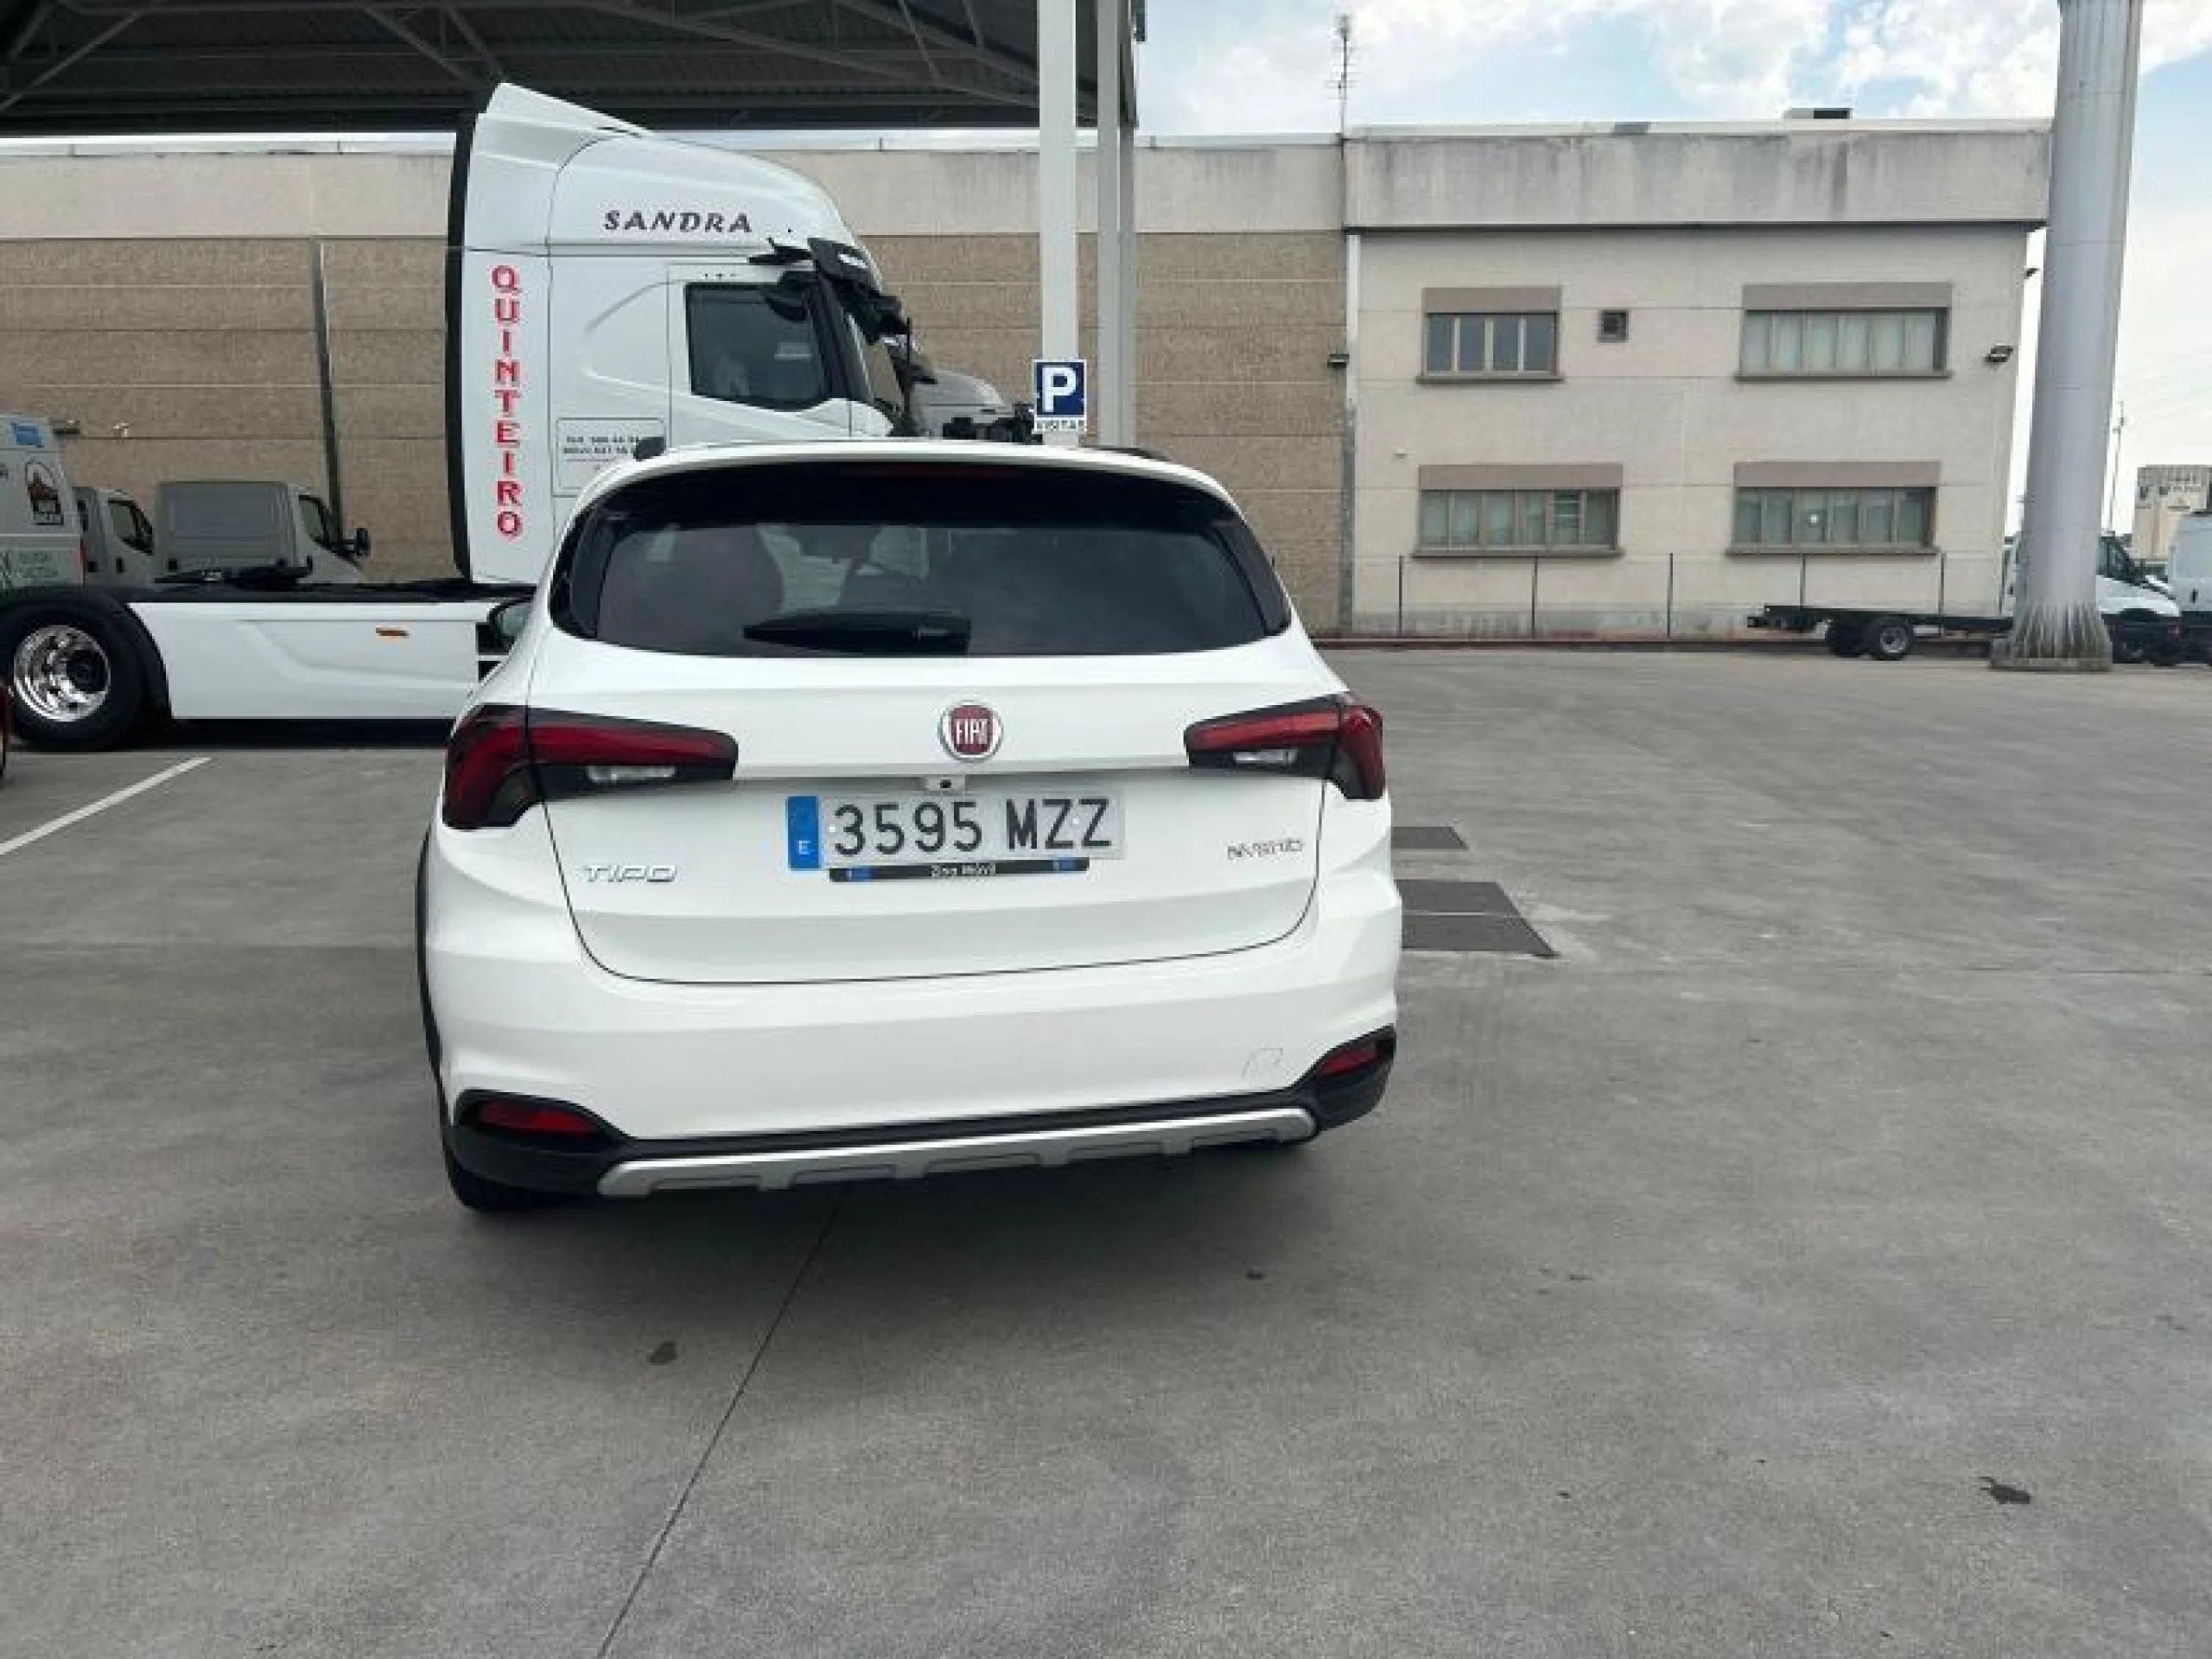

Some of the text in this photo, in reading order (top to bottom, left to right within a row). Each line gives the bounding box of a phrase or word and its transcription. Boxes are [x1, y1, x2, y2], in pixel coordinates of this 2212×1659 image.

[605, 210, 753, 232] SANDRA
[493, 264, 522, 535] QUINTEIRO
[1042, 366, 1077, 412] P
[954, 718, 988, 744] FIAT
[834, 798, 1111, 855] 3595 MZZ
[798, 840, 810, 855] E
[583, 865, 677, 883] TIPO
